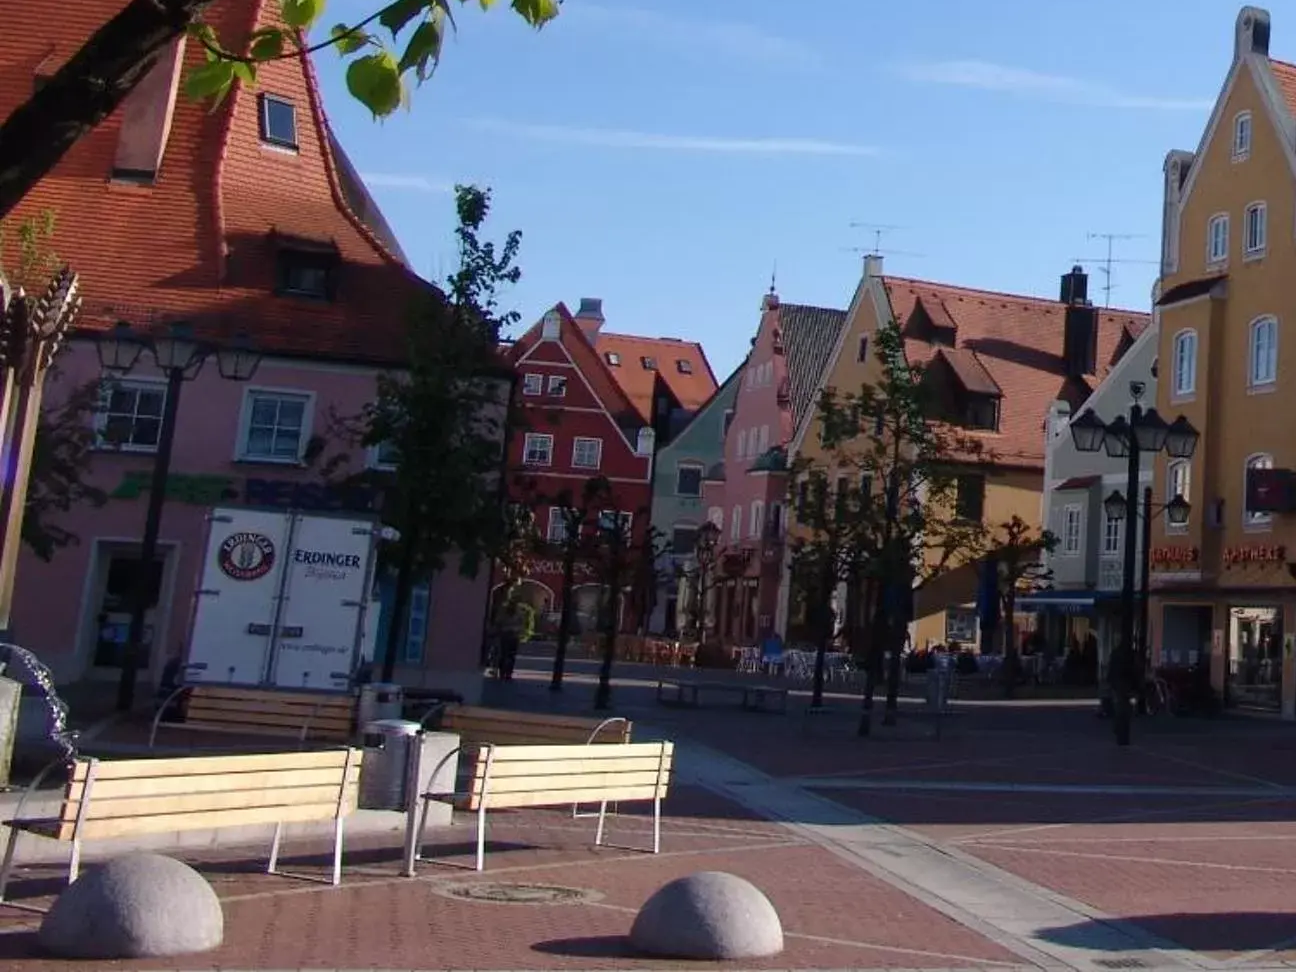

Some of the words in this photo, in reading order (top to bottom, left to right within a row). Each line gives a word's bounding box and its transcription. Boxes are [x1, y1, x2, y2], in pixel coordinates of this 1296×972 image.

[223, 532, 273, 555] ERDINGER
[294, 548, 361, 569] ERDINGER
[1222, 545, 1286, 564] APOTHEKE
